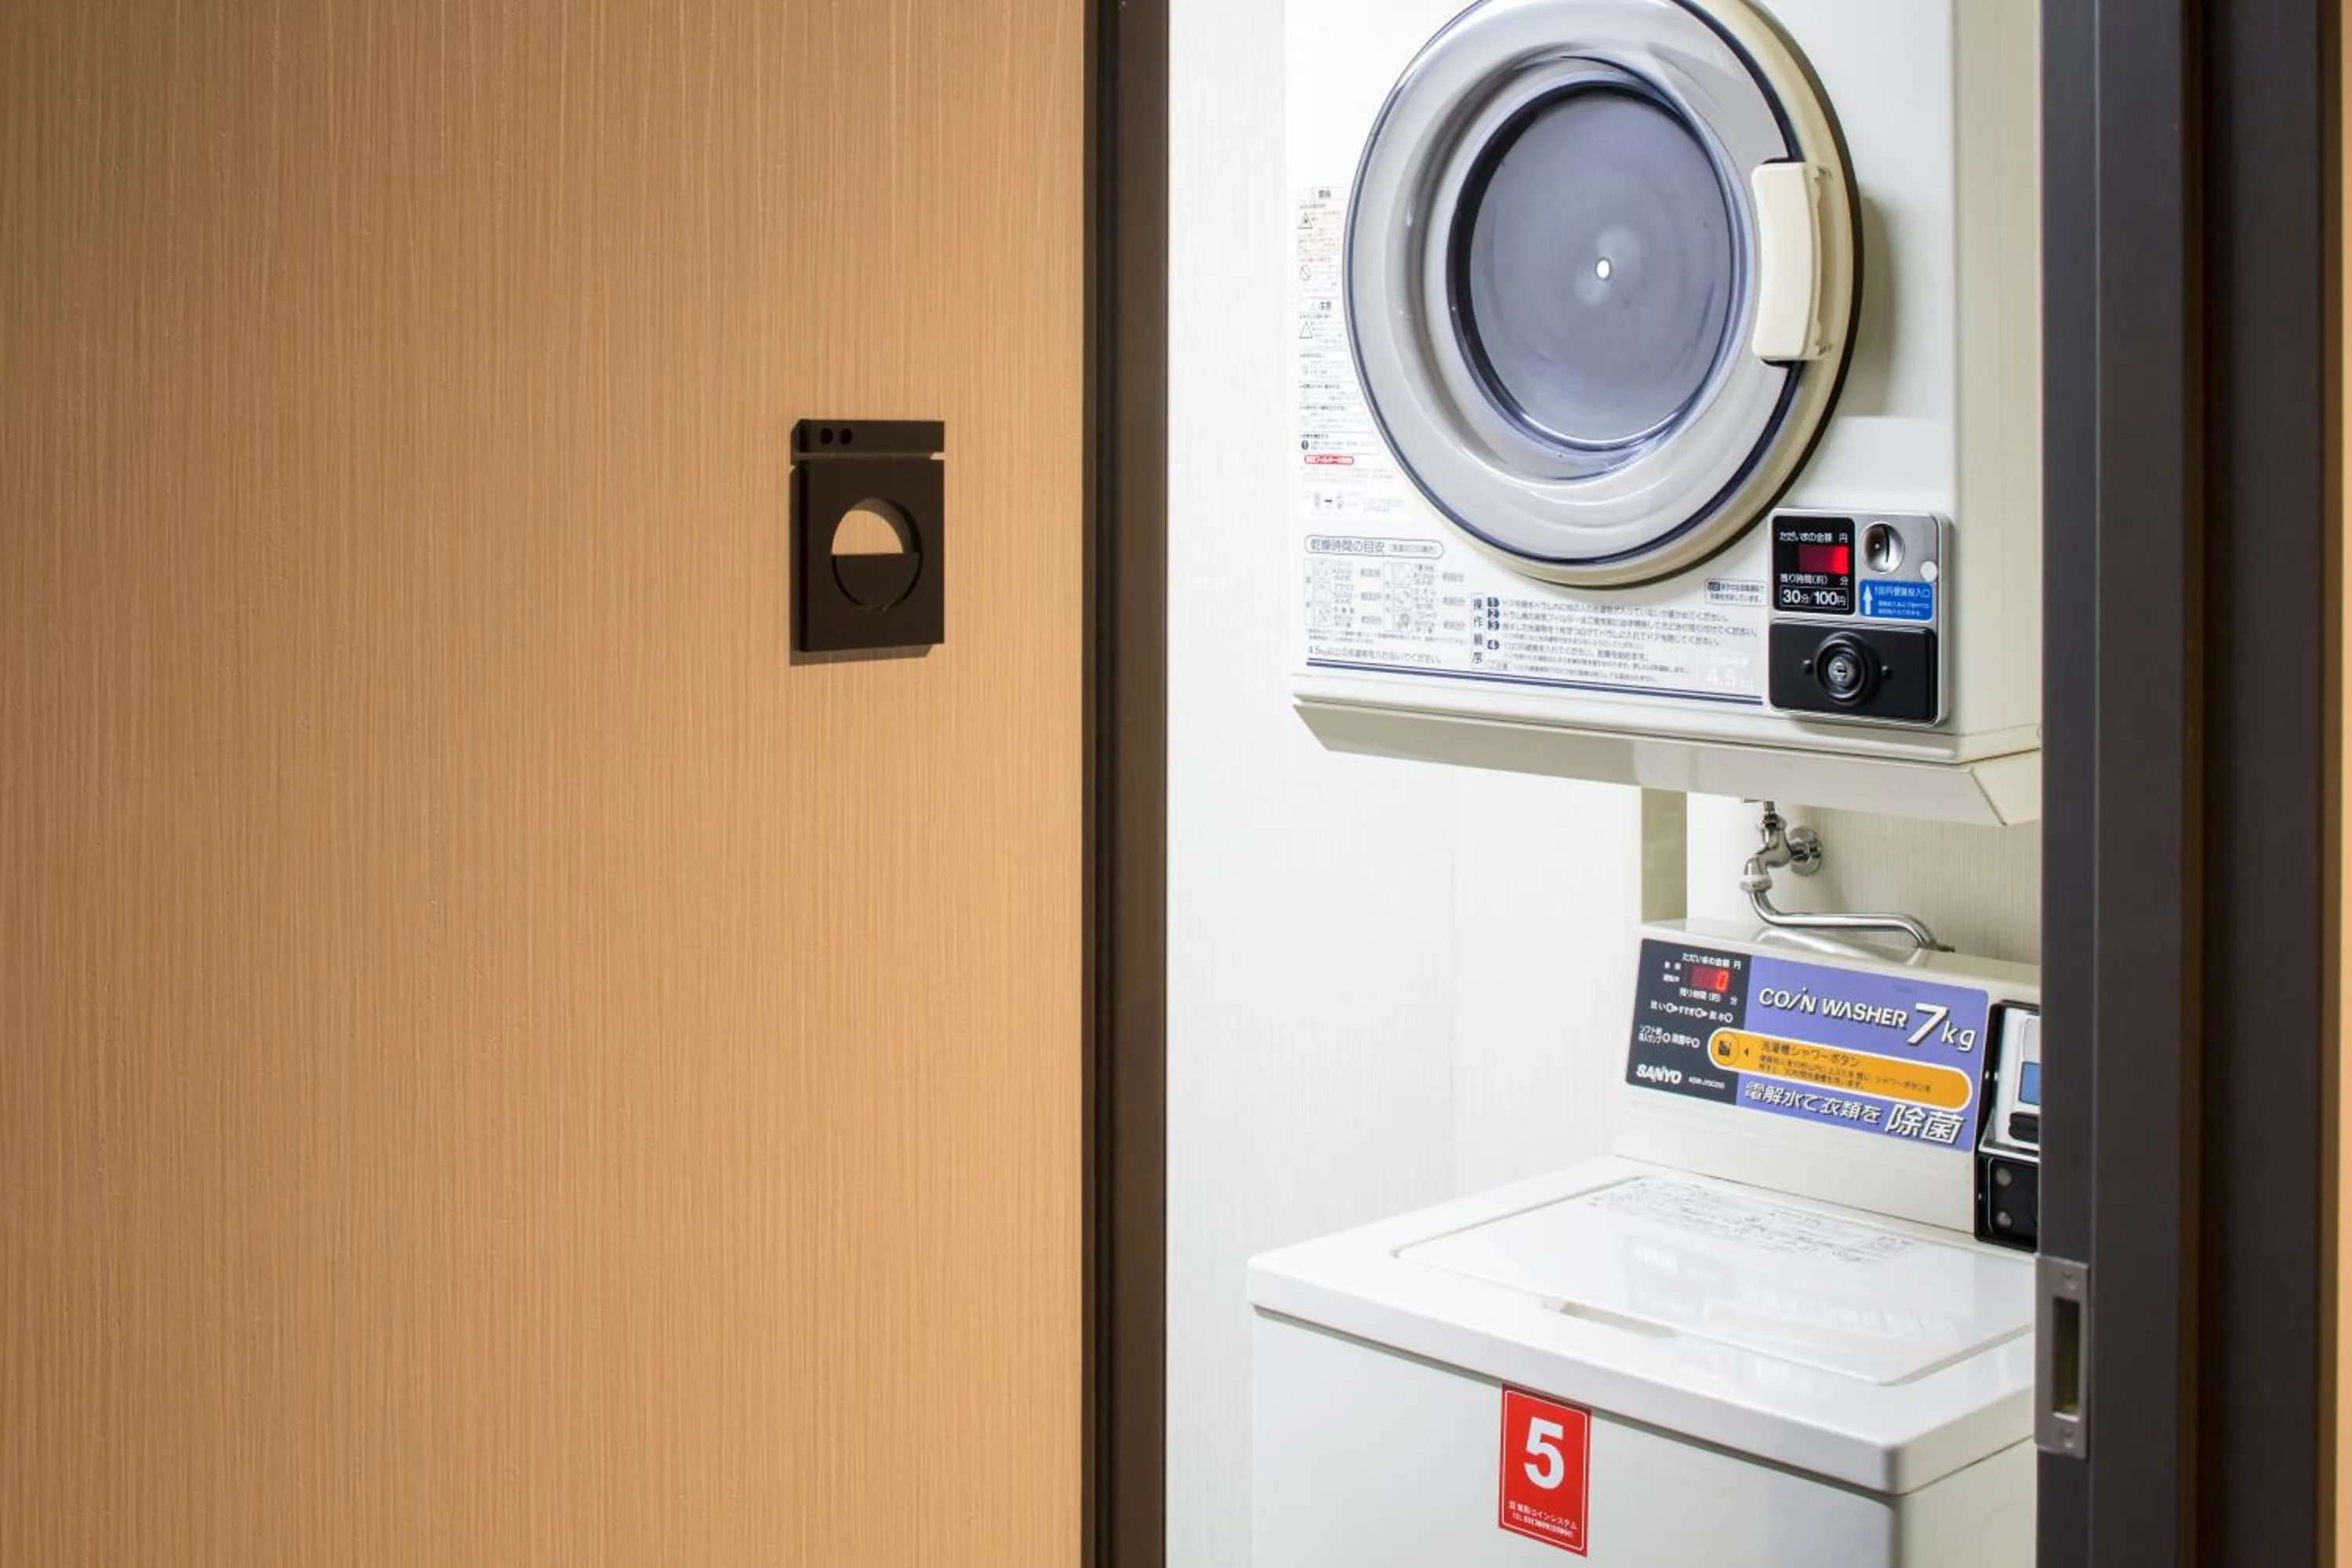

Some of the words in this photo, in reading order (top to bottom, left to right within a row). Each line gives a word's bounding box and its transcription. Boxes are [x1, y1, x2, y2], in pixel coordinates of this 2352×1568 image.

[1780, 532, 1832, 543] ただいまの金額
[1838, 532, 1848, 543] 円
[1840, 576, 1849, 586] 分
[1733, 960, 1741, 970] 円
[1715, 970, 1729, 991] 0
[1822, 998, 1908, 1027] WASHER
[1636, 1064, 1682, 1084] SANYO
[1745, 1081, 1882, 1124] 電解水で衣類を
[1885, 1105, 1963, 1145] 除菌
[1523, 1417, 1565, 1490] 5
